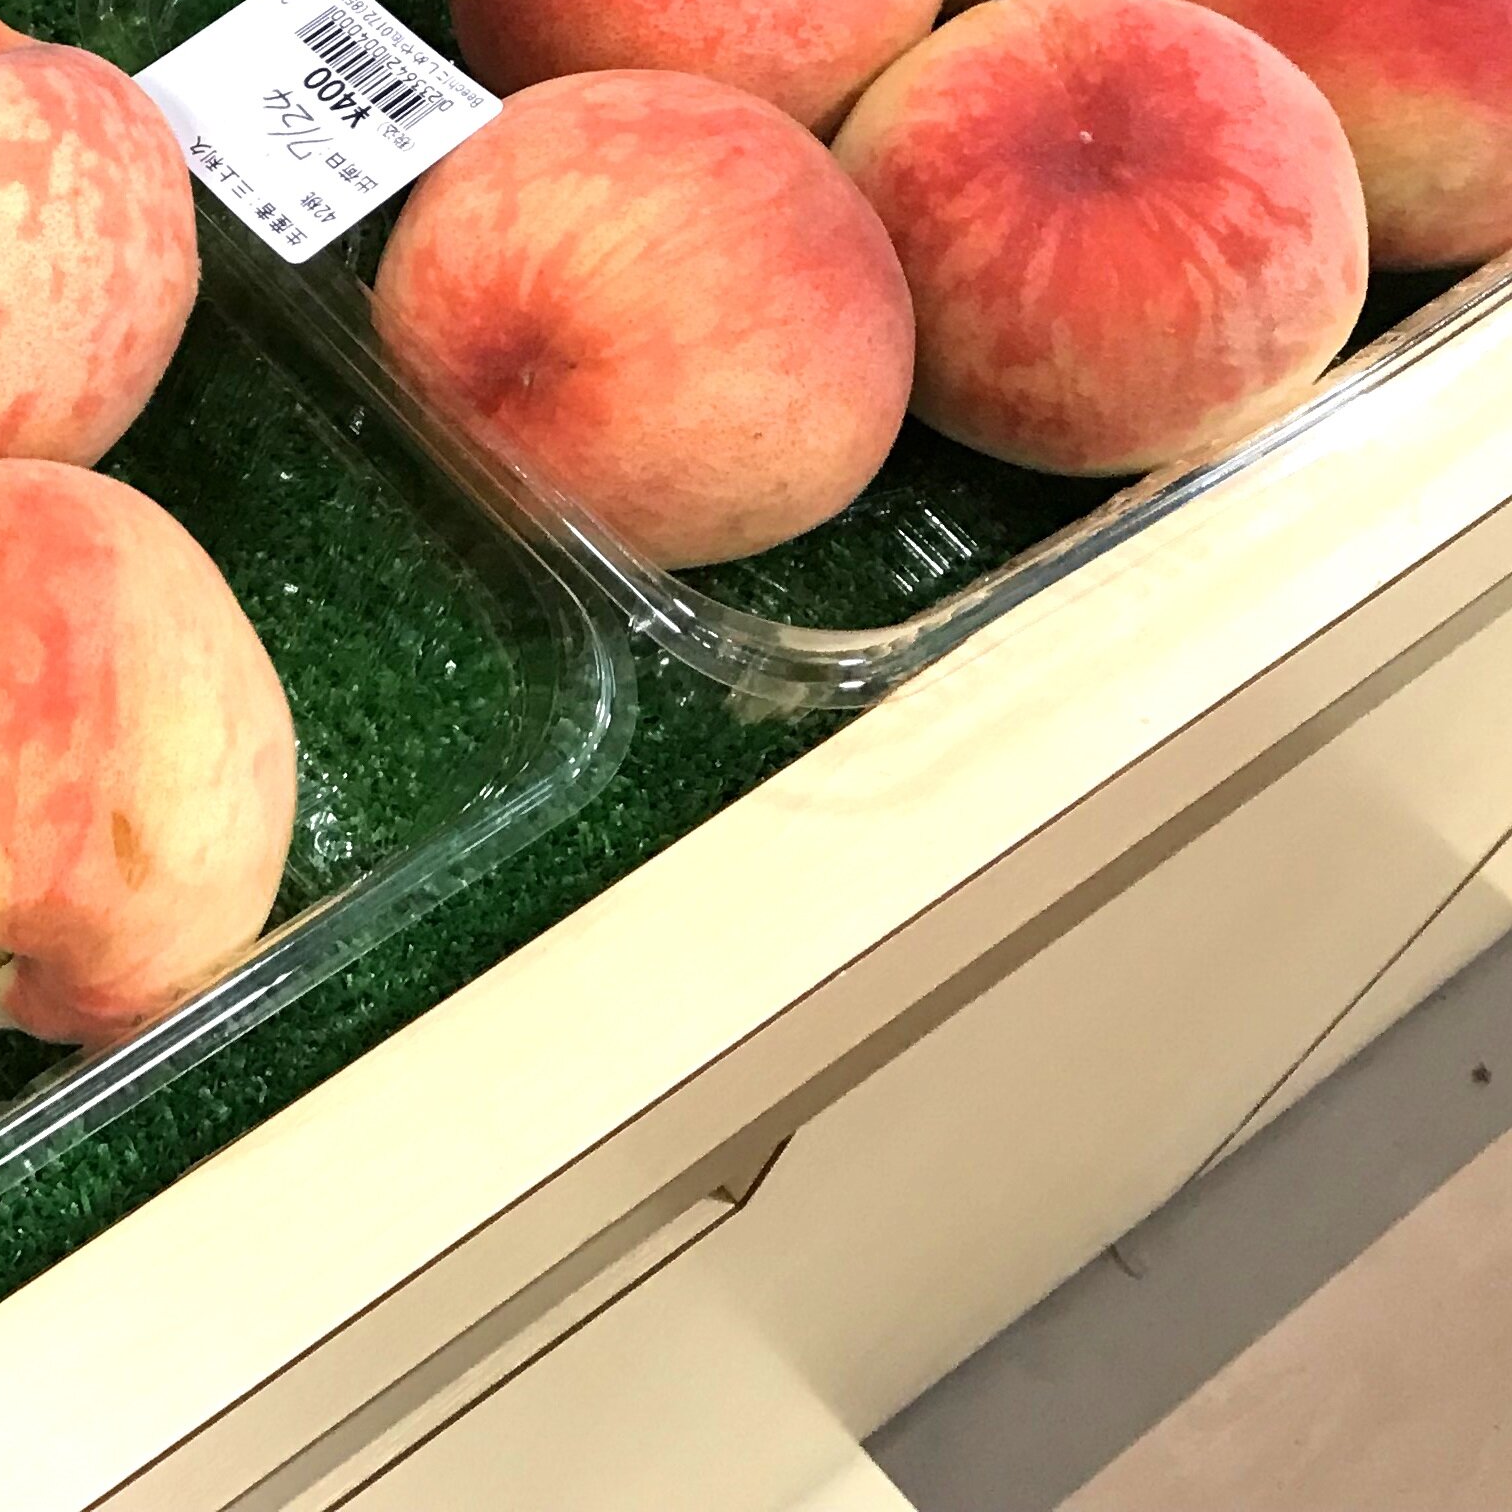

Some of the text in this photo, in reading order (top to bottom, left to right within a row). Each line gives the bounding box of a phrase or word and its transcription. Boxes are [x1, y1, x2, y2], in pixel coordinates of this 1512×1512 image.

[261, 87, 333, 161] 7/24
[302, 66, 372, 129] ¥400
[188, 134, 254, 199] 三上利久
[299, 190, 337, 223] 42桃
